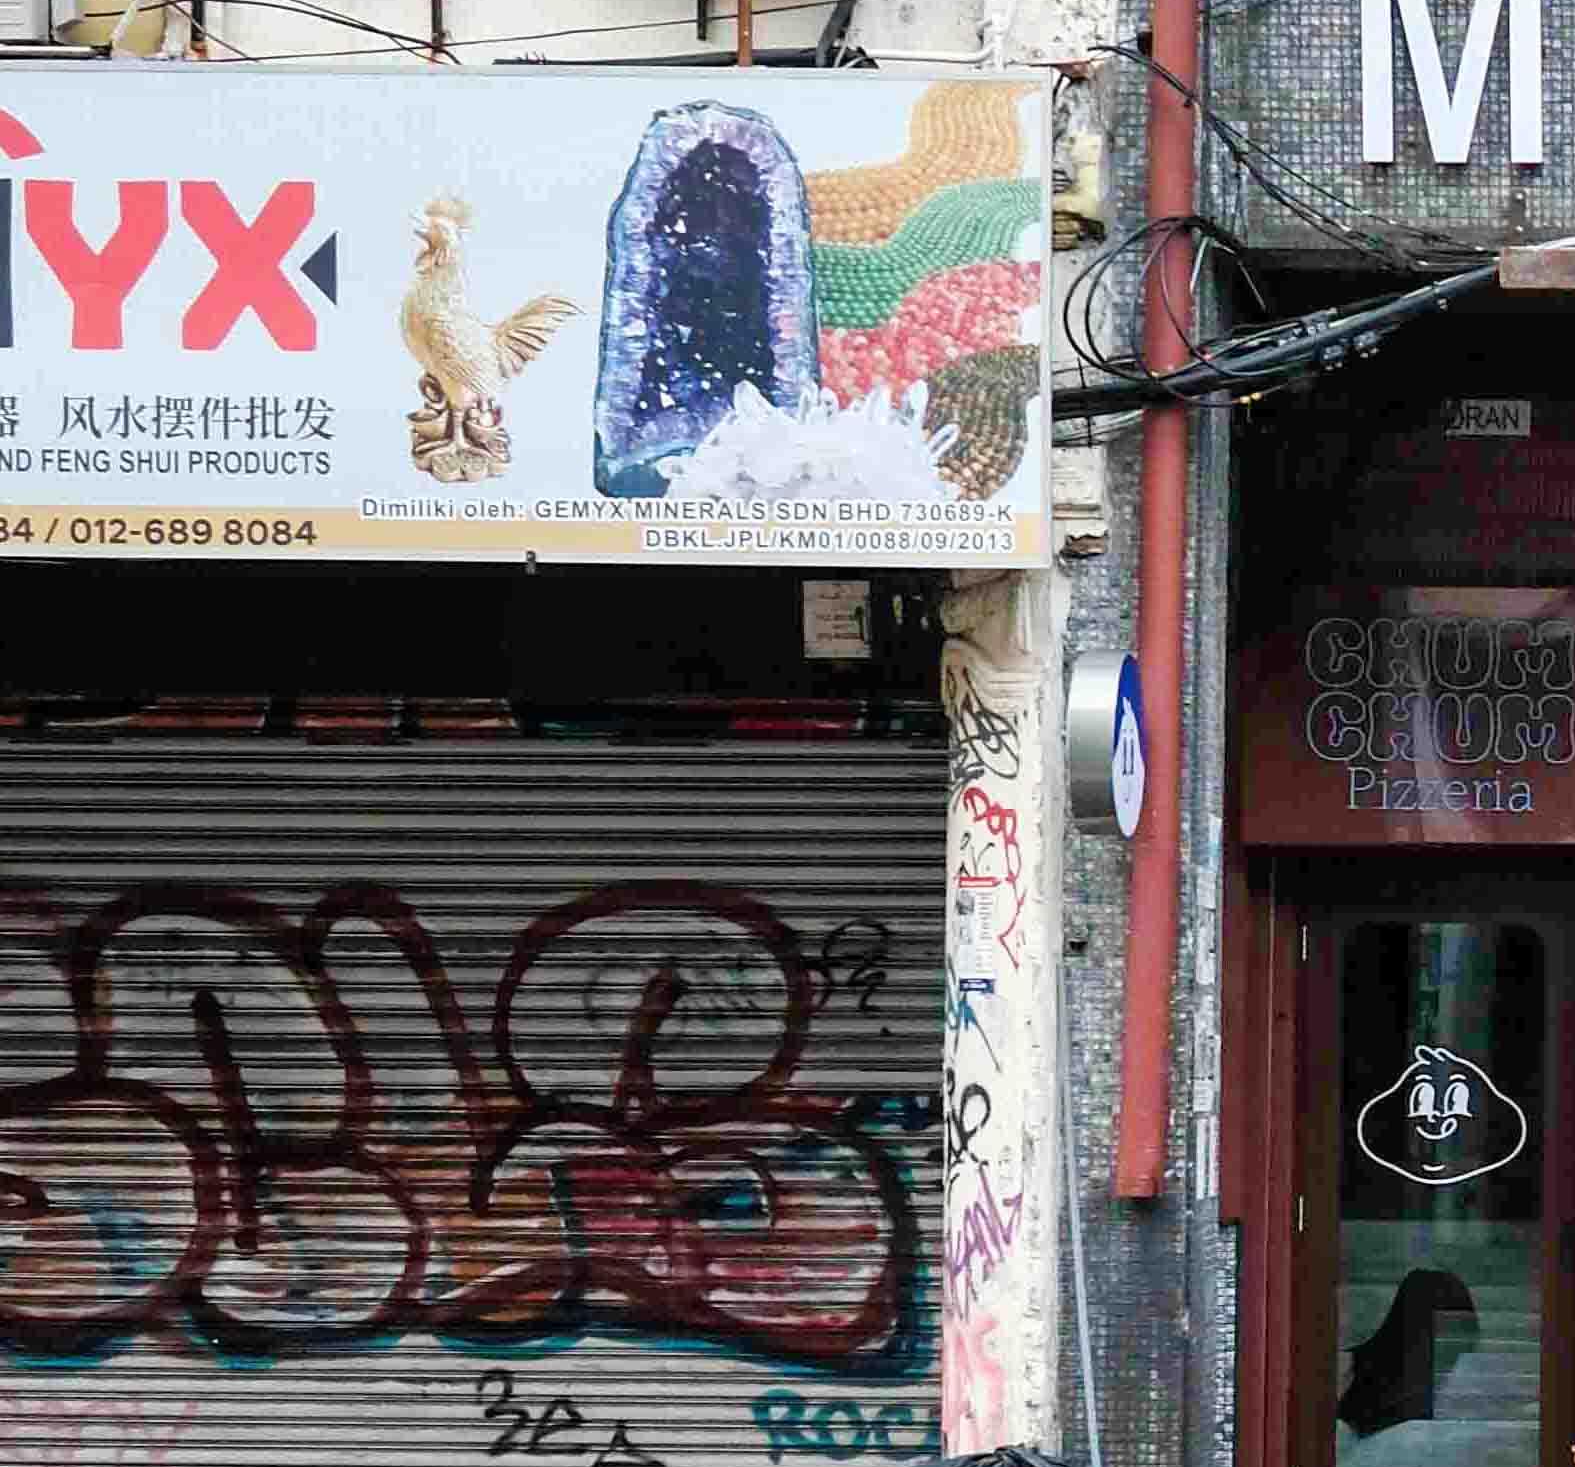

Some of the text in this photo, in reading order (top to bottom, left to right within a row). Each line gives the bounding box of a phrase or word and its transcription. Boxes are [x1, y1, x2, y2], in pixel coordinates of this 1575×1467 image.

[0, 177, 316, 352] YX
[60, 394, 337, 441] 风水摆件批发
[41, 448, 111, 474] FENG
[119, 450, 180, 475] SHUI
[188, 450, 332, 476] PRODUCTS
[69, 517, 213, 546] 012-689
[223, 519, 318, 547] 8084
[362, 497, 1014, 523] Dimiliki oleh: GEMYX MINERALS SDN BHD 730689-K
[1306, 617, 1575, 690] CHUM
[1306, 691, 1575, 764] CHUM
[1346, 766, 1536, 813] Pizzeria
